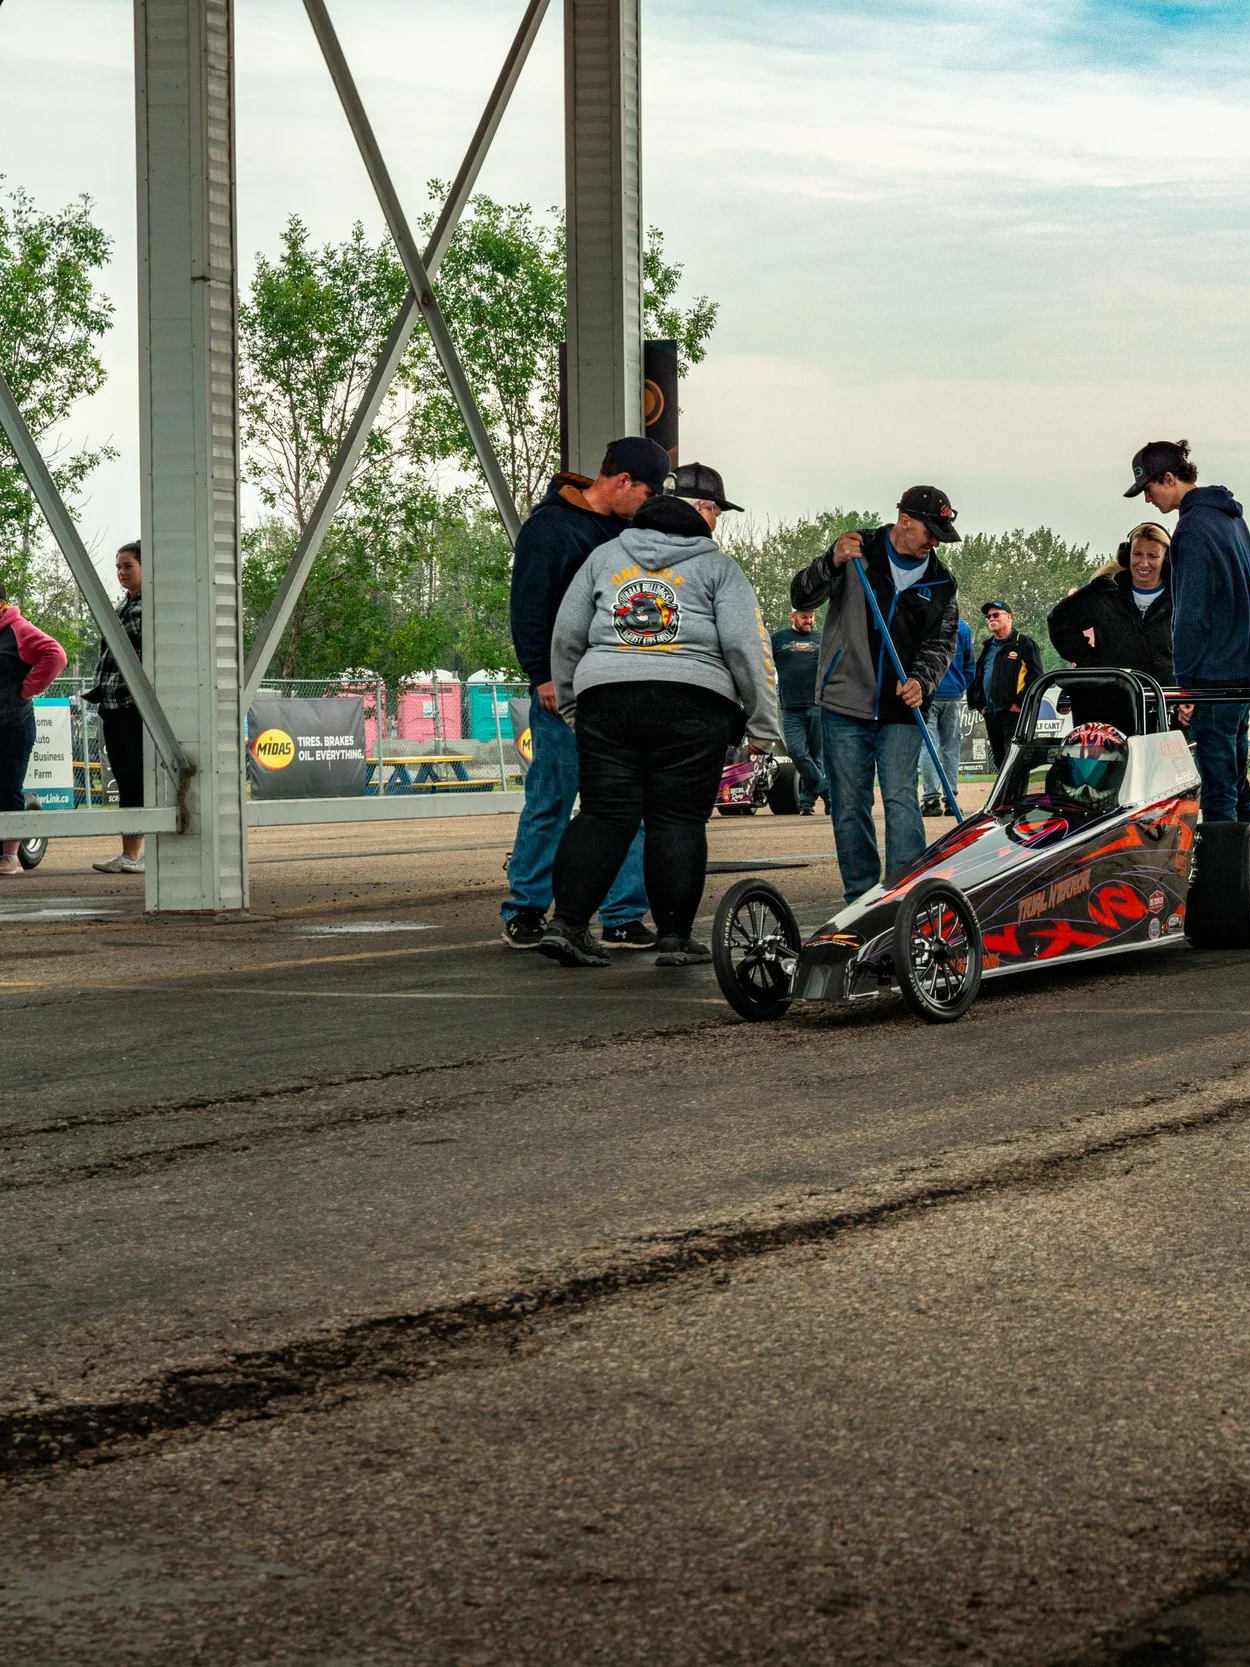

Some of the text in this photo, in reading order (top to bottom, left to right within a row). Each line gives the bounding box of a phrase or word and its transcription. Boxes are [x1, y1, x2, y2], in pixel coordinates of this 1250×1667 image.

[36, 719, 53, 727] ome
[297, 736, 354, 747] TIRES. BRAKES
[33, 751, 65, 761] Business
[298, 749, 365, 761] OIL. EVERYTHING.
[33, 769, 53, 779] Farm
